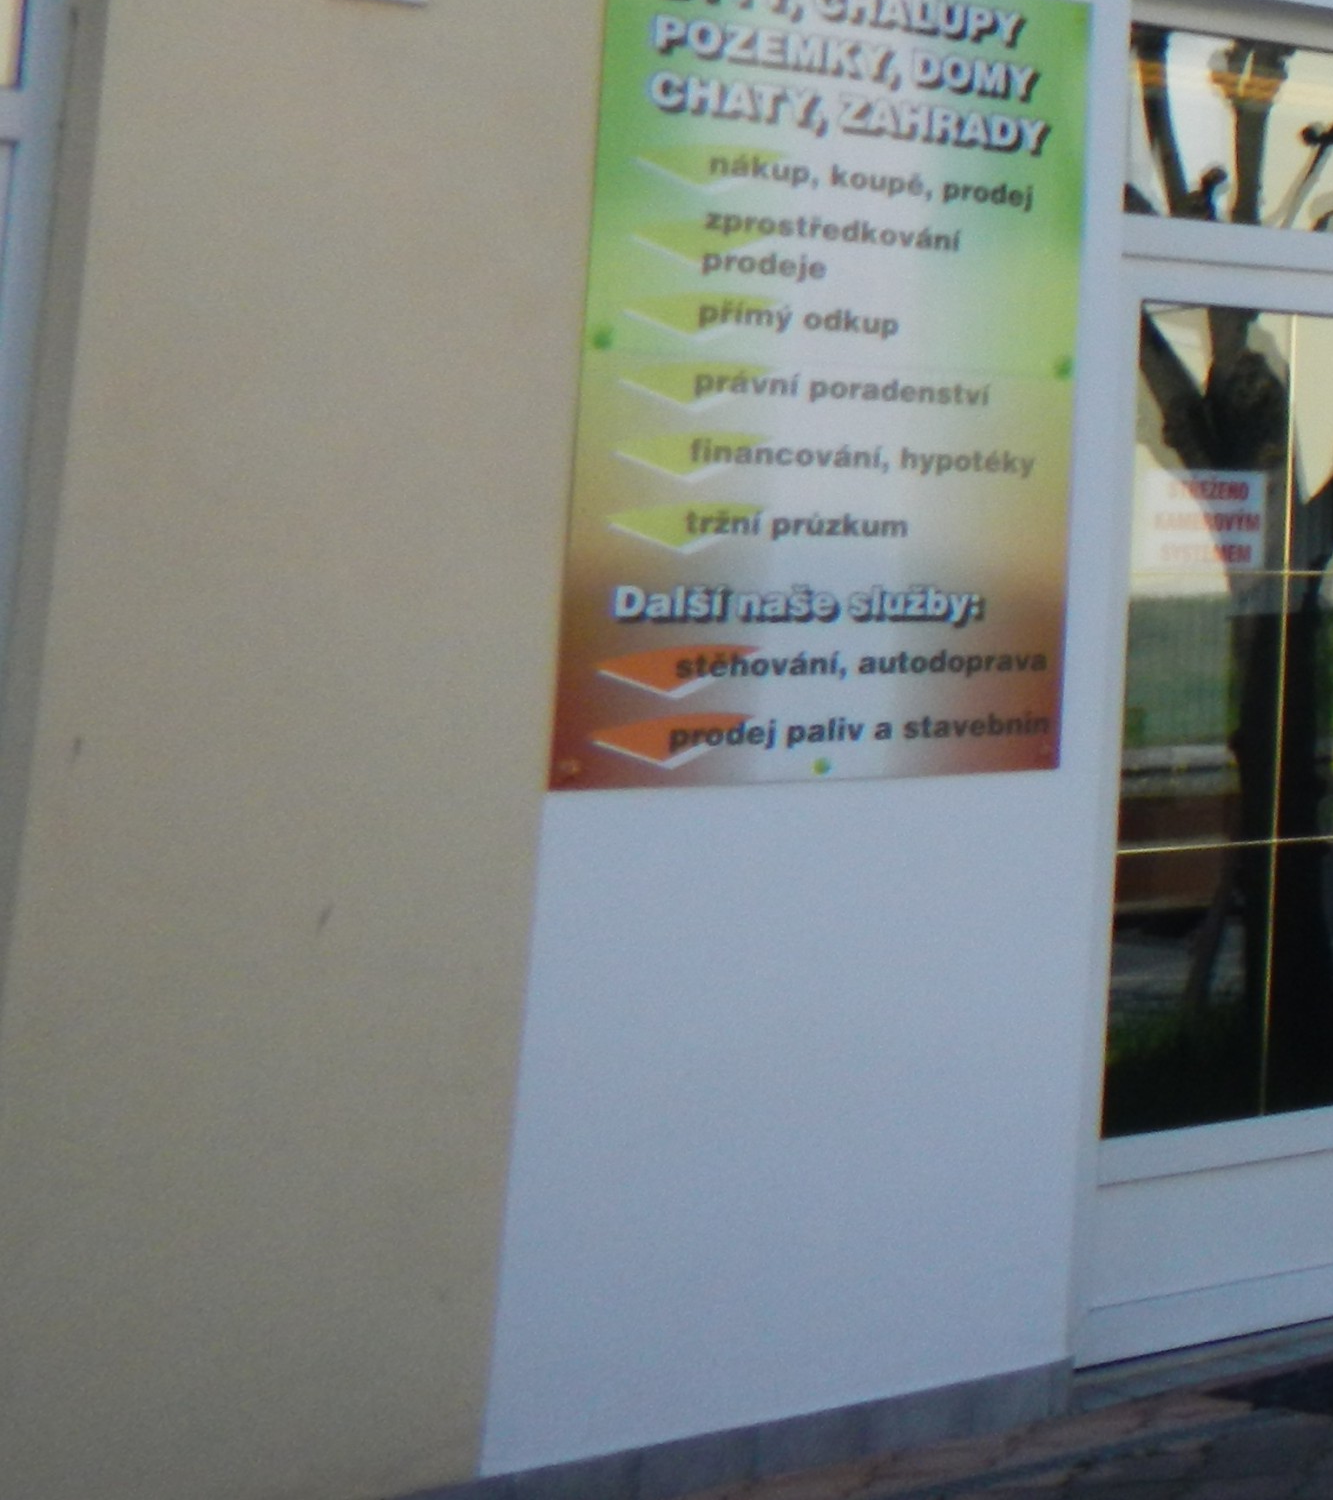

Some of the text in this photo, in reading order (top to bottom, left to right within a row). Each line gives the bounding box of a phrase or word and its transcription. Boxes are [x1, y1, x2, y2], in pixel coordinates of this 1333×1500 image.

[652, 14, 1041, 102] POZEMKY, DOMY
[650, 70, 1051, 156] CHATY, ZAHRADY
[709, 152, 819, 190] nákup,
[943, 178, 1034, 212] prodej
[704, 209, 961, 252] zprostředkování
[702, 250, 827, 282] prodeje
[699, 300, 899, 339] přímý odkup
[694, 370, 991, 407] právní poradenství
[690, 438, 1035, 479] financování, hypotéky
[686, 509, 761, 537] tržní
[611, 585, 985, 628] Další naše služby:
[676, 649, 1047, 680] stěhování, autodoprava
[669, 709, 1050, 753] prodej paliv a stavebnin
